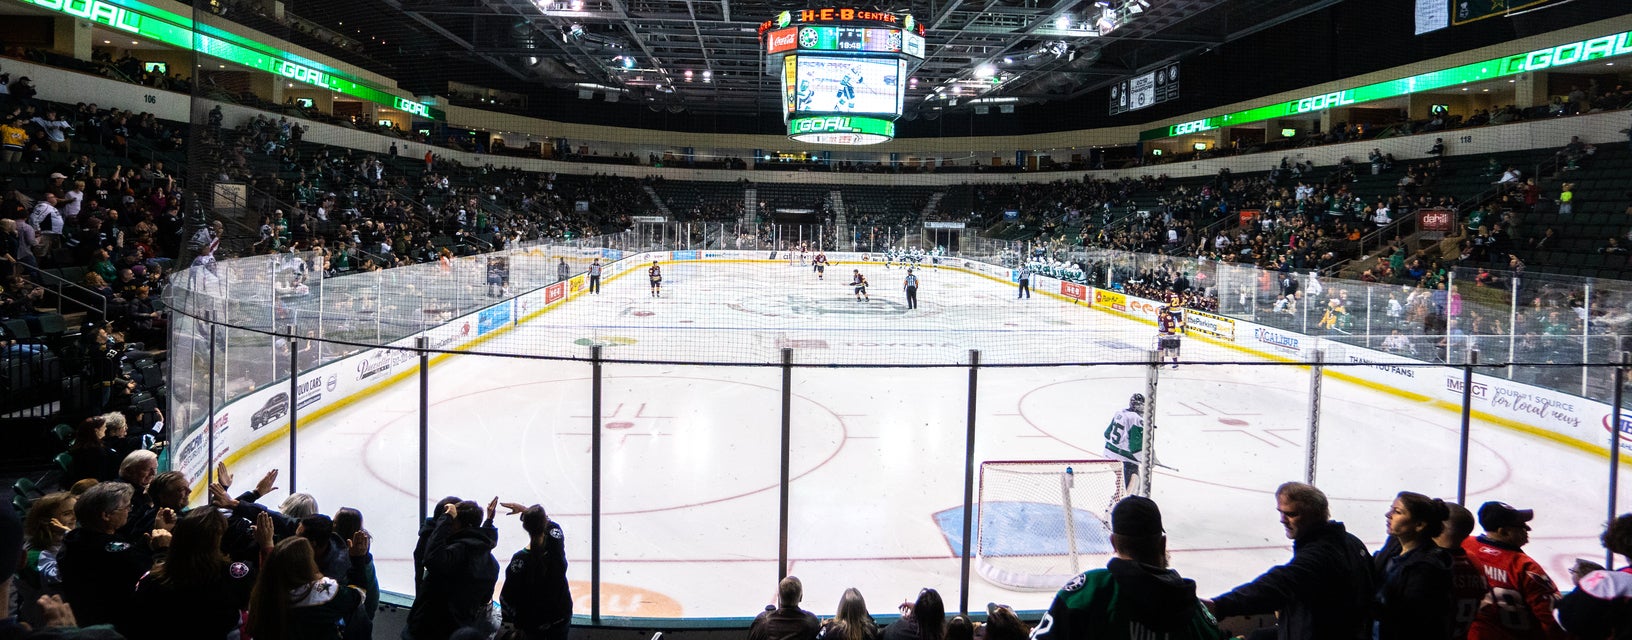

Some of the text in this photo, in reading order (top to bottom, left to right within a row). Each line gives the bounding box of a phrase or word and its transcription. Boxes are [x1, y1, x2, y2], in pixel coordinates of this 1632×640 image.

[802, 8, 896, 23] H-E-B CENTER
[282, 62, 329, 89] GOAL
[144, 94, 156, 104] 106
[1297, 90, 1354, 113] GOAL
[401, 99, 429, 117] GOAL
[800, 116, 852, 131] GOAL
[1176, 118, 1211, 135] GOAL
[1460, 135, 1472, 144] 118
[1391, 366, 1414, 378] FANS!
[310, 376, 321, 390] CARS
[1447, 378, 1488, 397] IMPCT
[1494, 386, 1519, 398] YOUR
[1535, 396, 1574, 413] SOURCE
[1491, 390, 1581, 428] for local news
[1483, 564, 1507, 583] MIN
